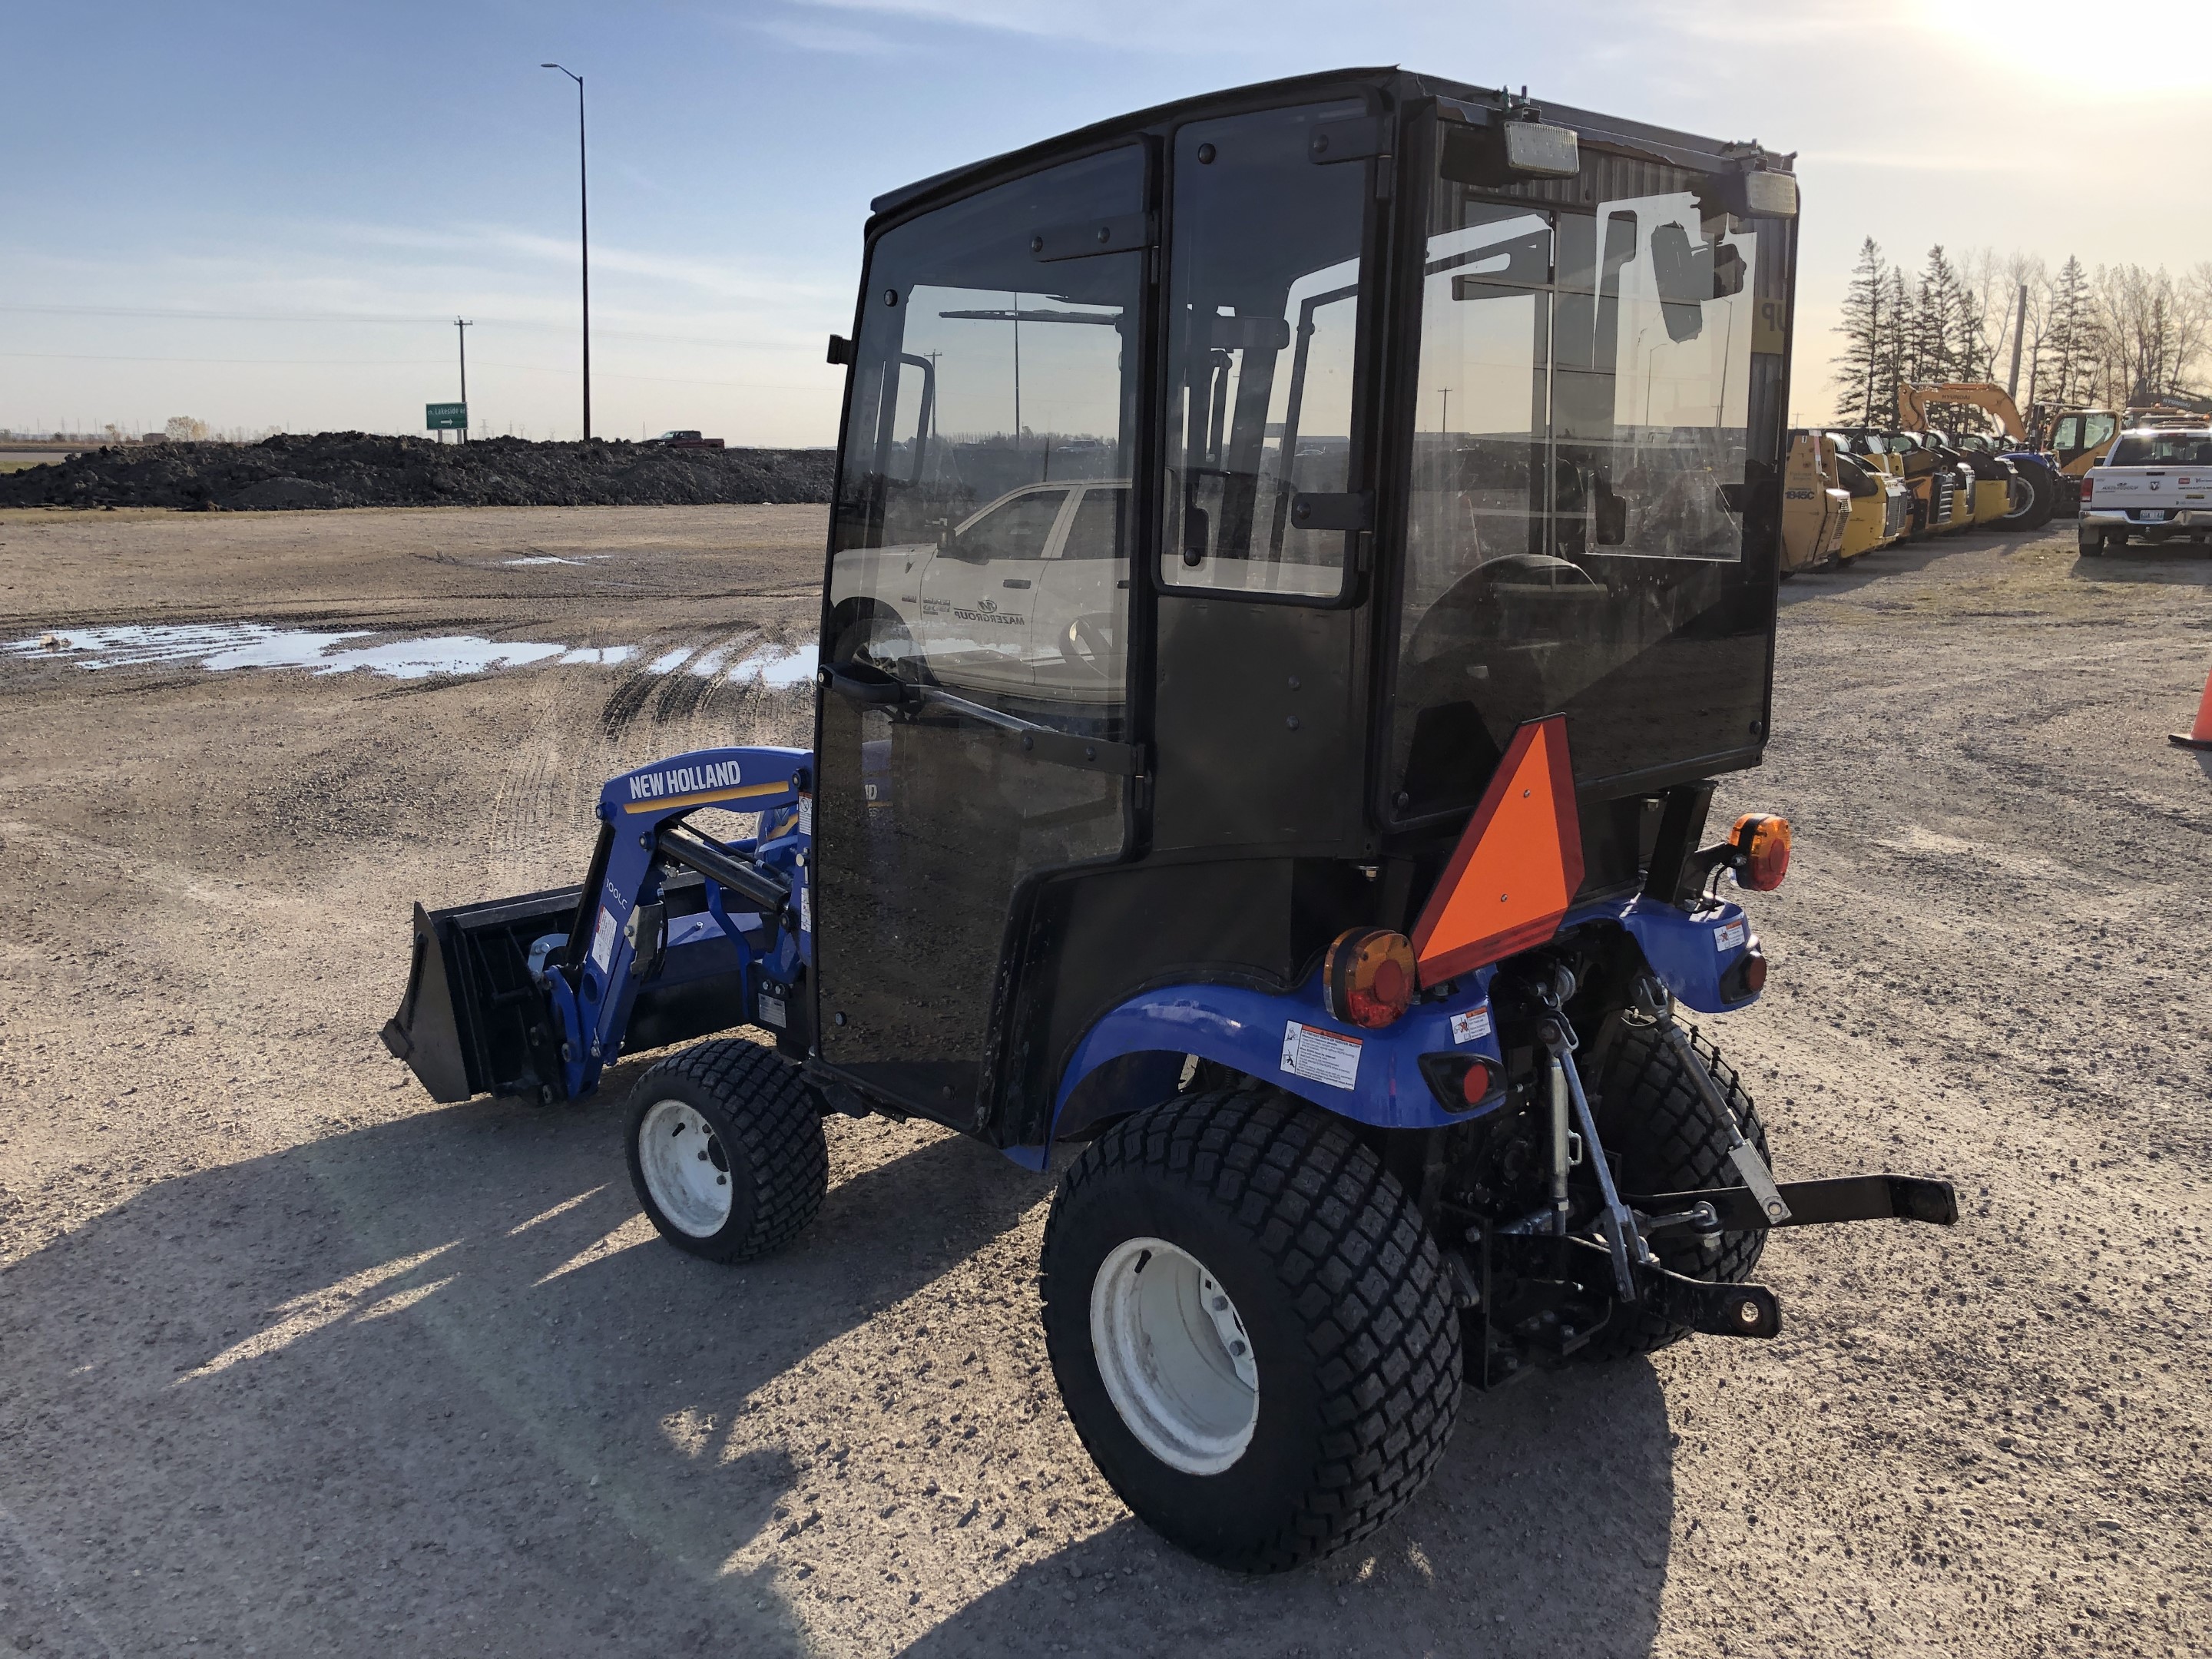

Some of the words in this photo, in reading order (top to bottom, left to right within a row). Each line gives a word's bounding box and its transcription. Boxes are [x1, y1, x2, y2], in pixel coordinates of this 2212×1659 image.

[2162, 398, 2191, 408] HYUNDAI
[629, 772, 664, 800] NEW
[666, 760, 741, 794] HOLLAND
[605, 878, 628, 910] 100LC
